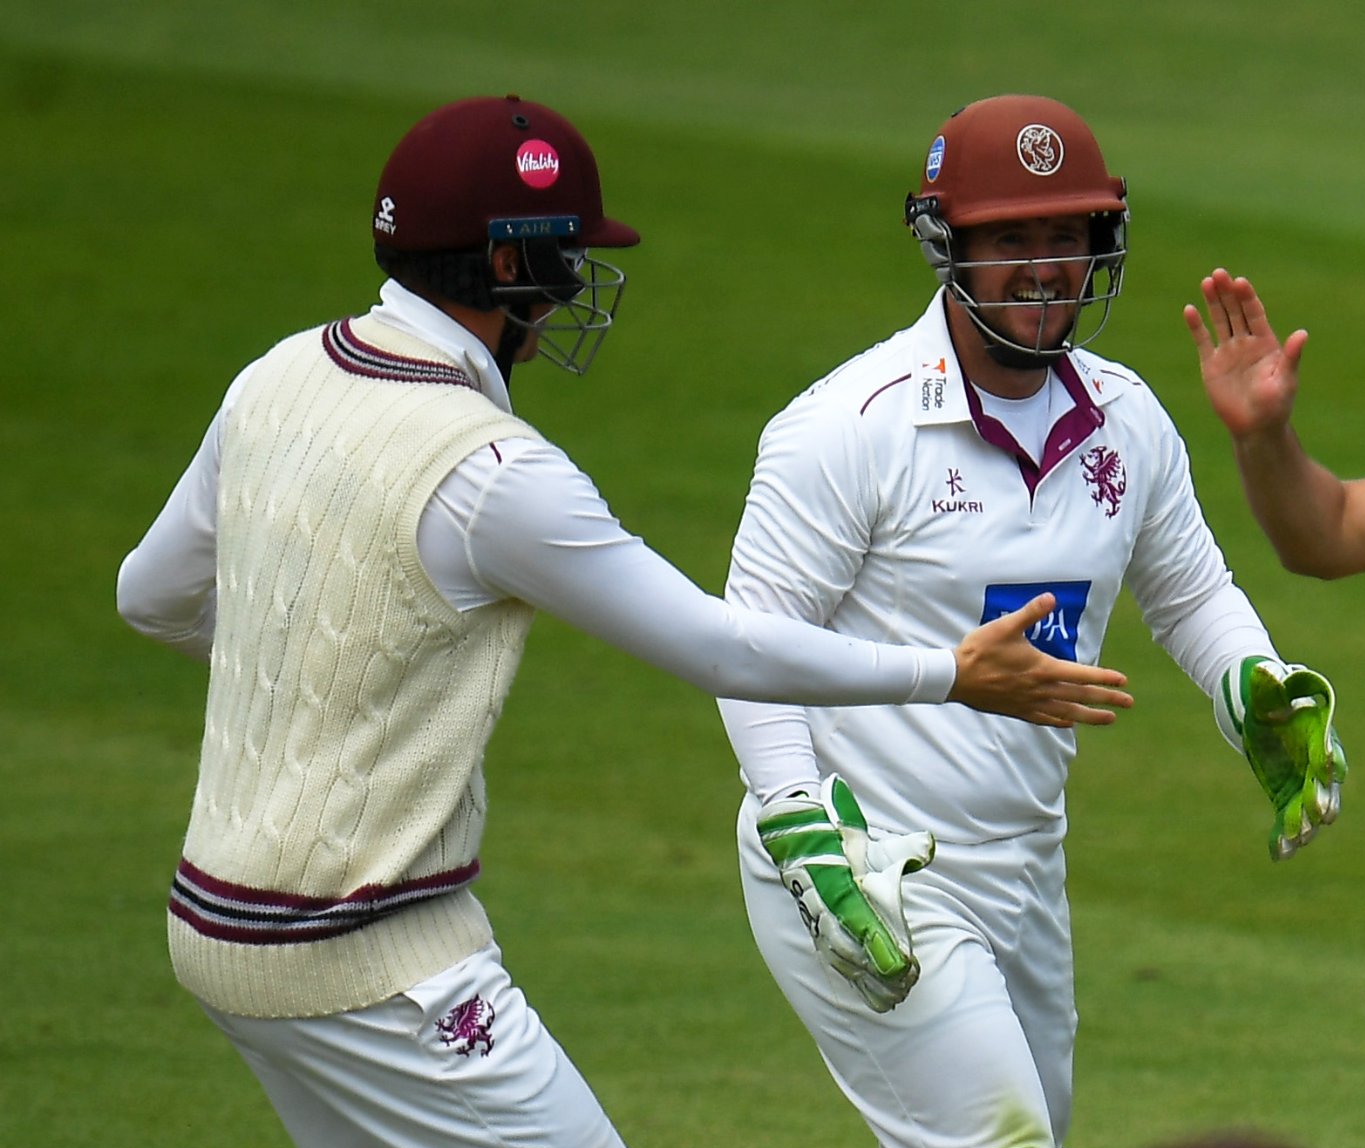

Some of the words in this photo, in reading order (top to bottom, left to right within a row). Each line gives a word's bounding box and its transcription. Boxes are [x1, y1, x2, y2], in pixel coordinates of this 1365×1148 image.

[516, 152, 559, 174] Vitality
[922, 377, 933, 411] Nation
[935, 376, 946, 409] Trade
[932, 500, 983, 513] KUKRI
